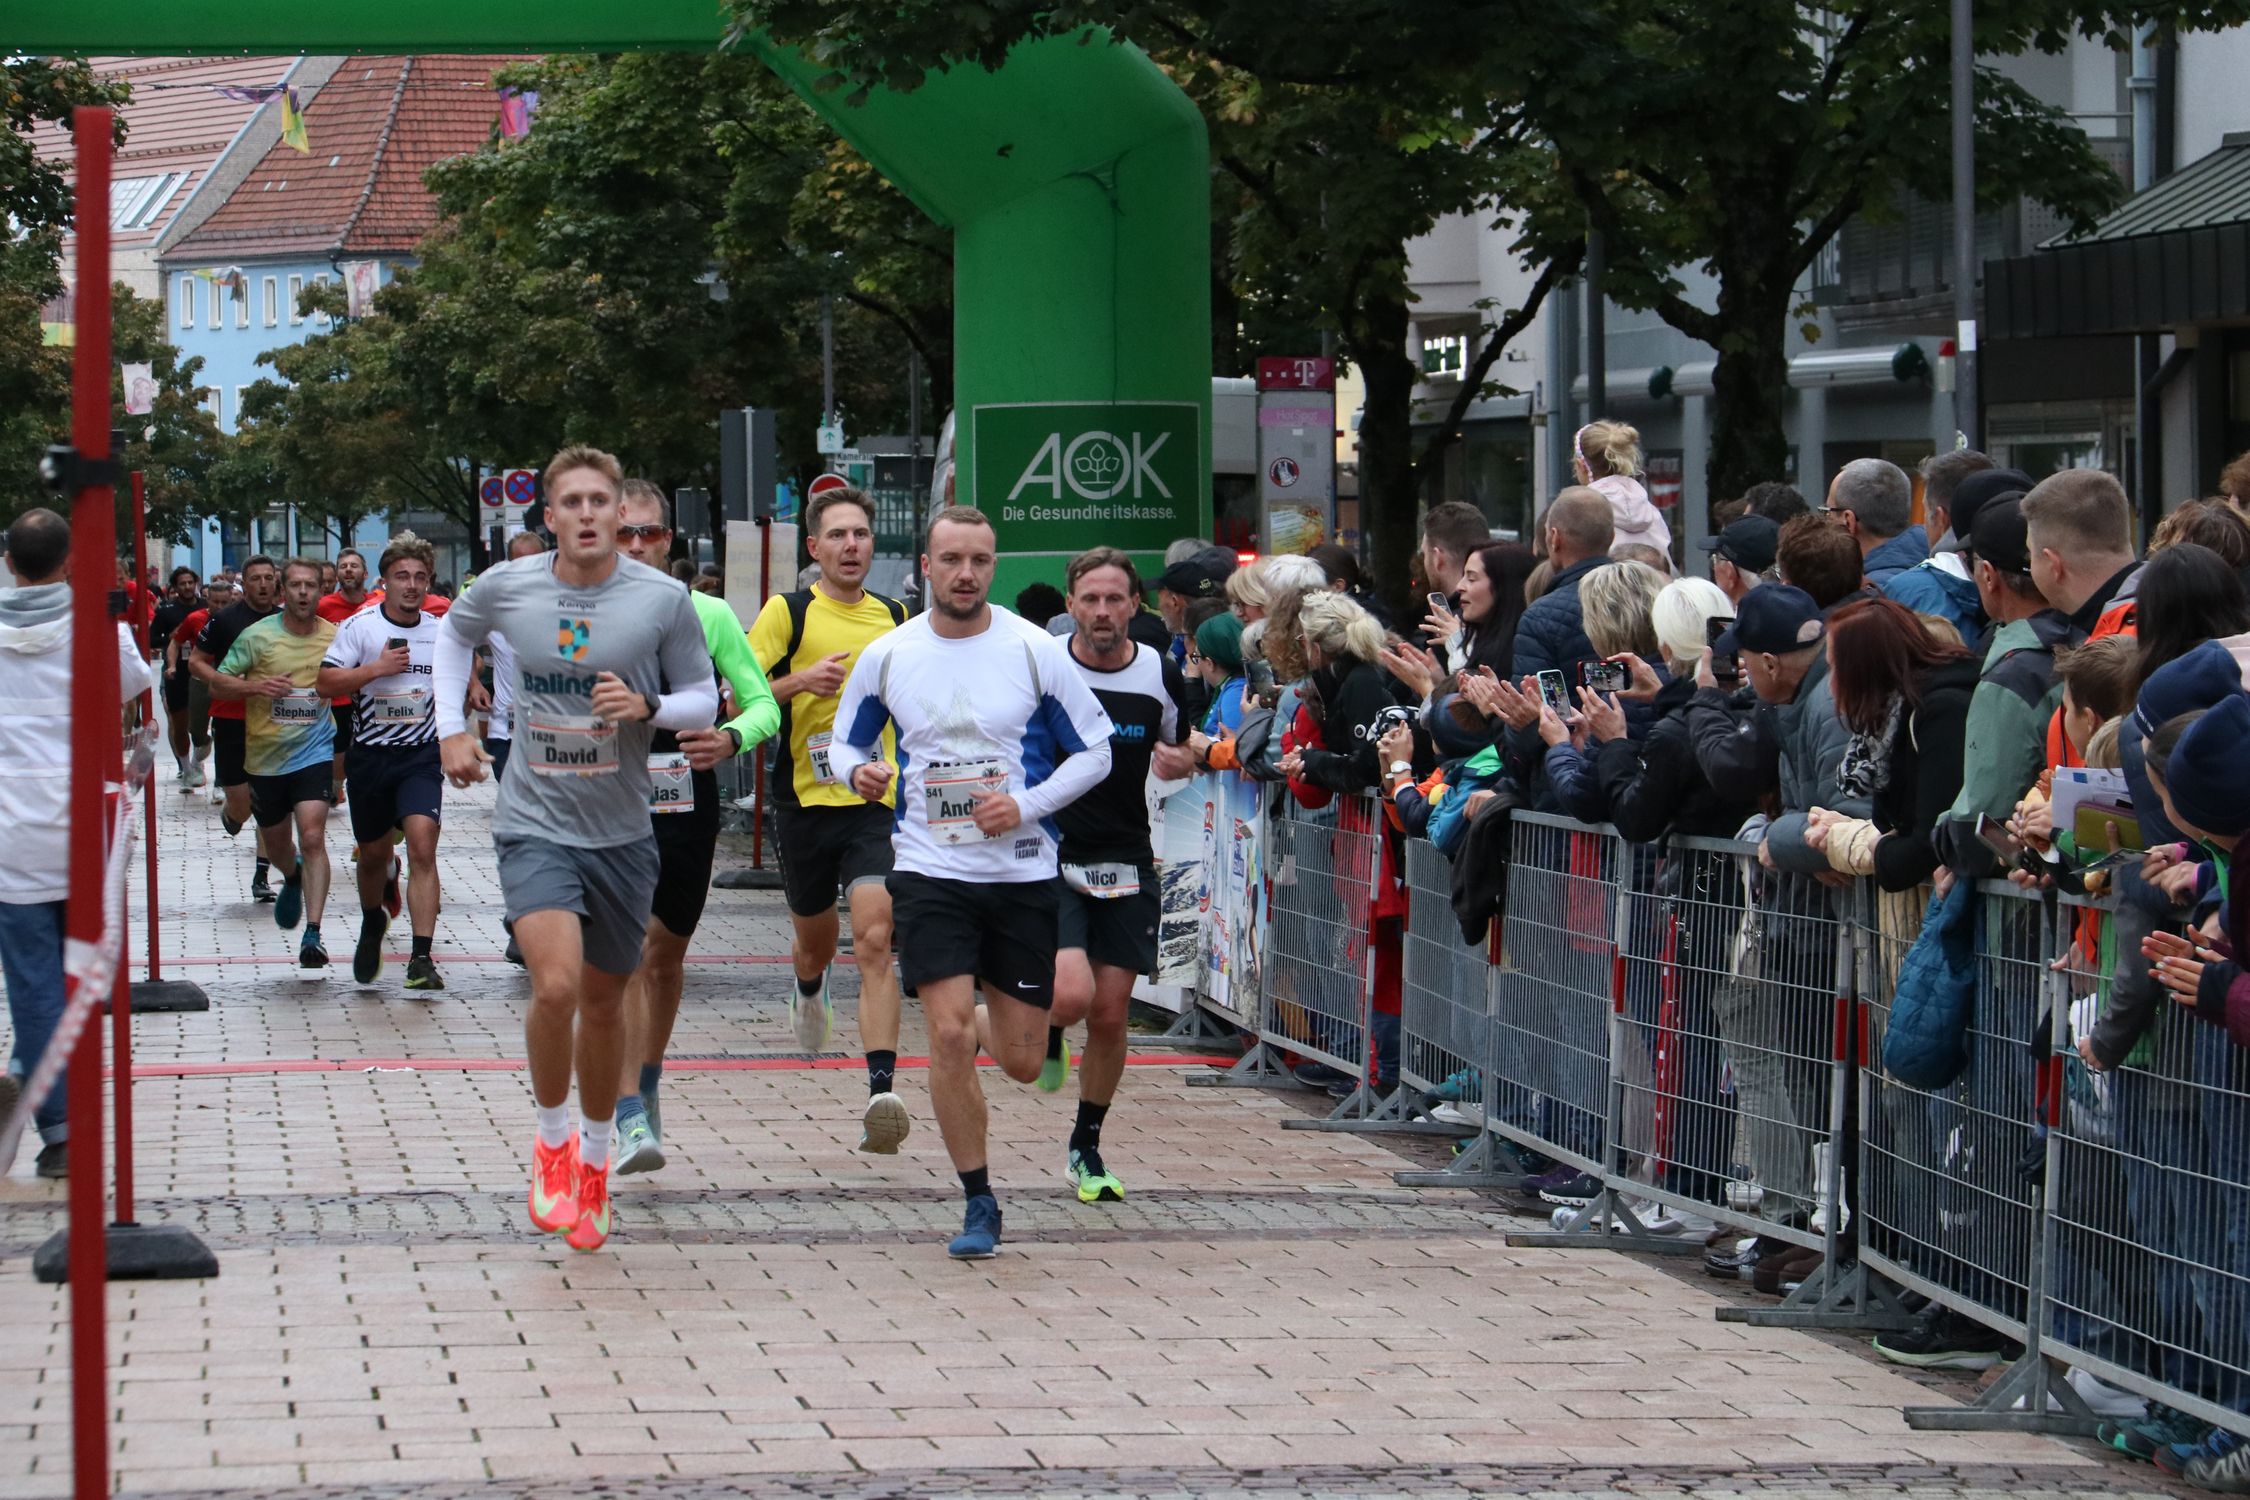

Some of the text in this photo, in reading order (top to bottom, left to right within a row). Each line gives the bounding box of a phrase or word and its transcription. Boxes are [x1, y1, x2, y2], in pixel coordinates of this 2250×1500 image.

[1007, 431, 1173, 500] AOK
[1003, 503, 1177, 521] Die Gesundheitskasse.
[405, 664, 433, 675] ERB
[273, 706, 318, 720] Stephan
[386, 706, 415, 717] Felix
[1114, 723, 1145, 737] MA
[545, 745, 598, 764] David
[811, 751, 829, 762] 184
[654, 786, 680, 802] ias
[926, 787, 943, 798] 541
[940, 798, 982, 818] And
[1084, 869, 1118, 886] Nico
